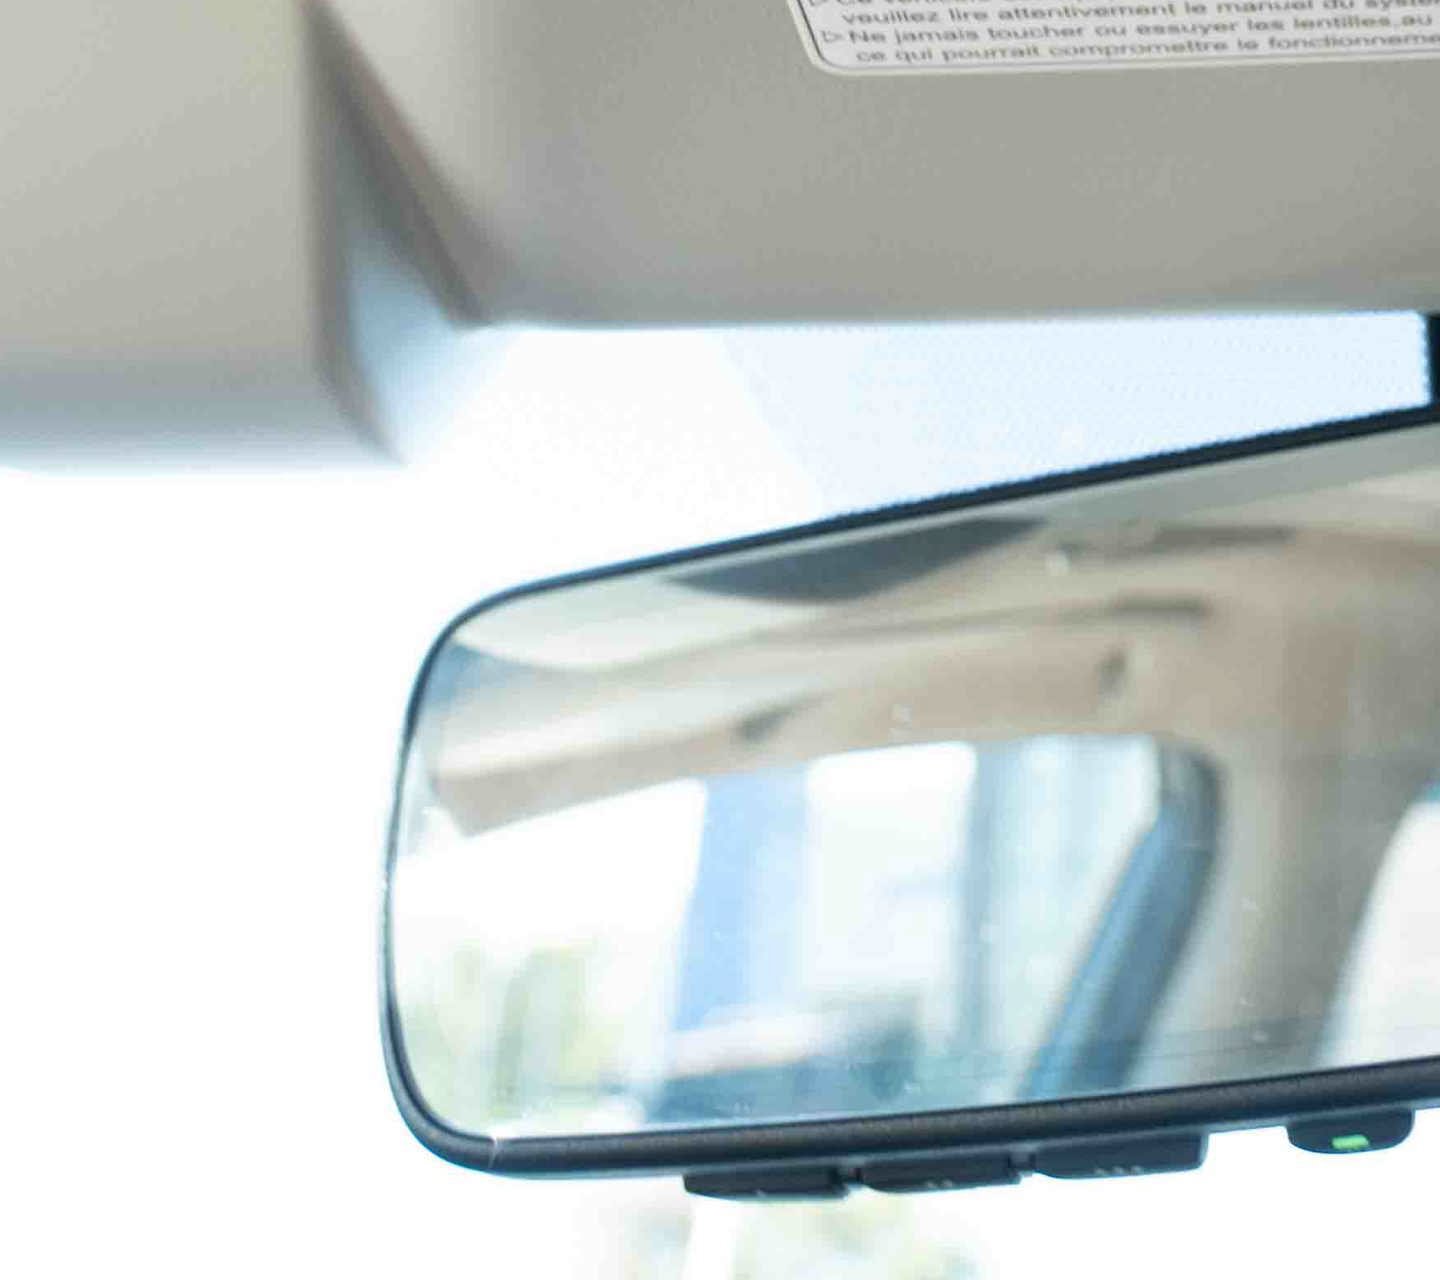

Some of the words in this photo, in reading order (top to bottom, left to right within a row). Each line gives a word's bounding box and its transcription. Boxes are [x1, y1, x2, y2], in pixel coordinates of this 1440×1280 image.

[842, 9, 939, 24] veuillez
[949, 6, 988, 21] lire
[998, 2, 1175, 20] attentivement
[1185, 1, 1207, 15] le
[849, 30, 885, 44] Ne
[894, 28, 980, 43] jamais
[988, 23, 1083, 40] toucher
[1095, 25, 1127, 38] ou
